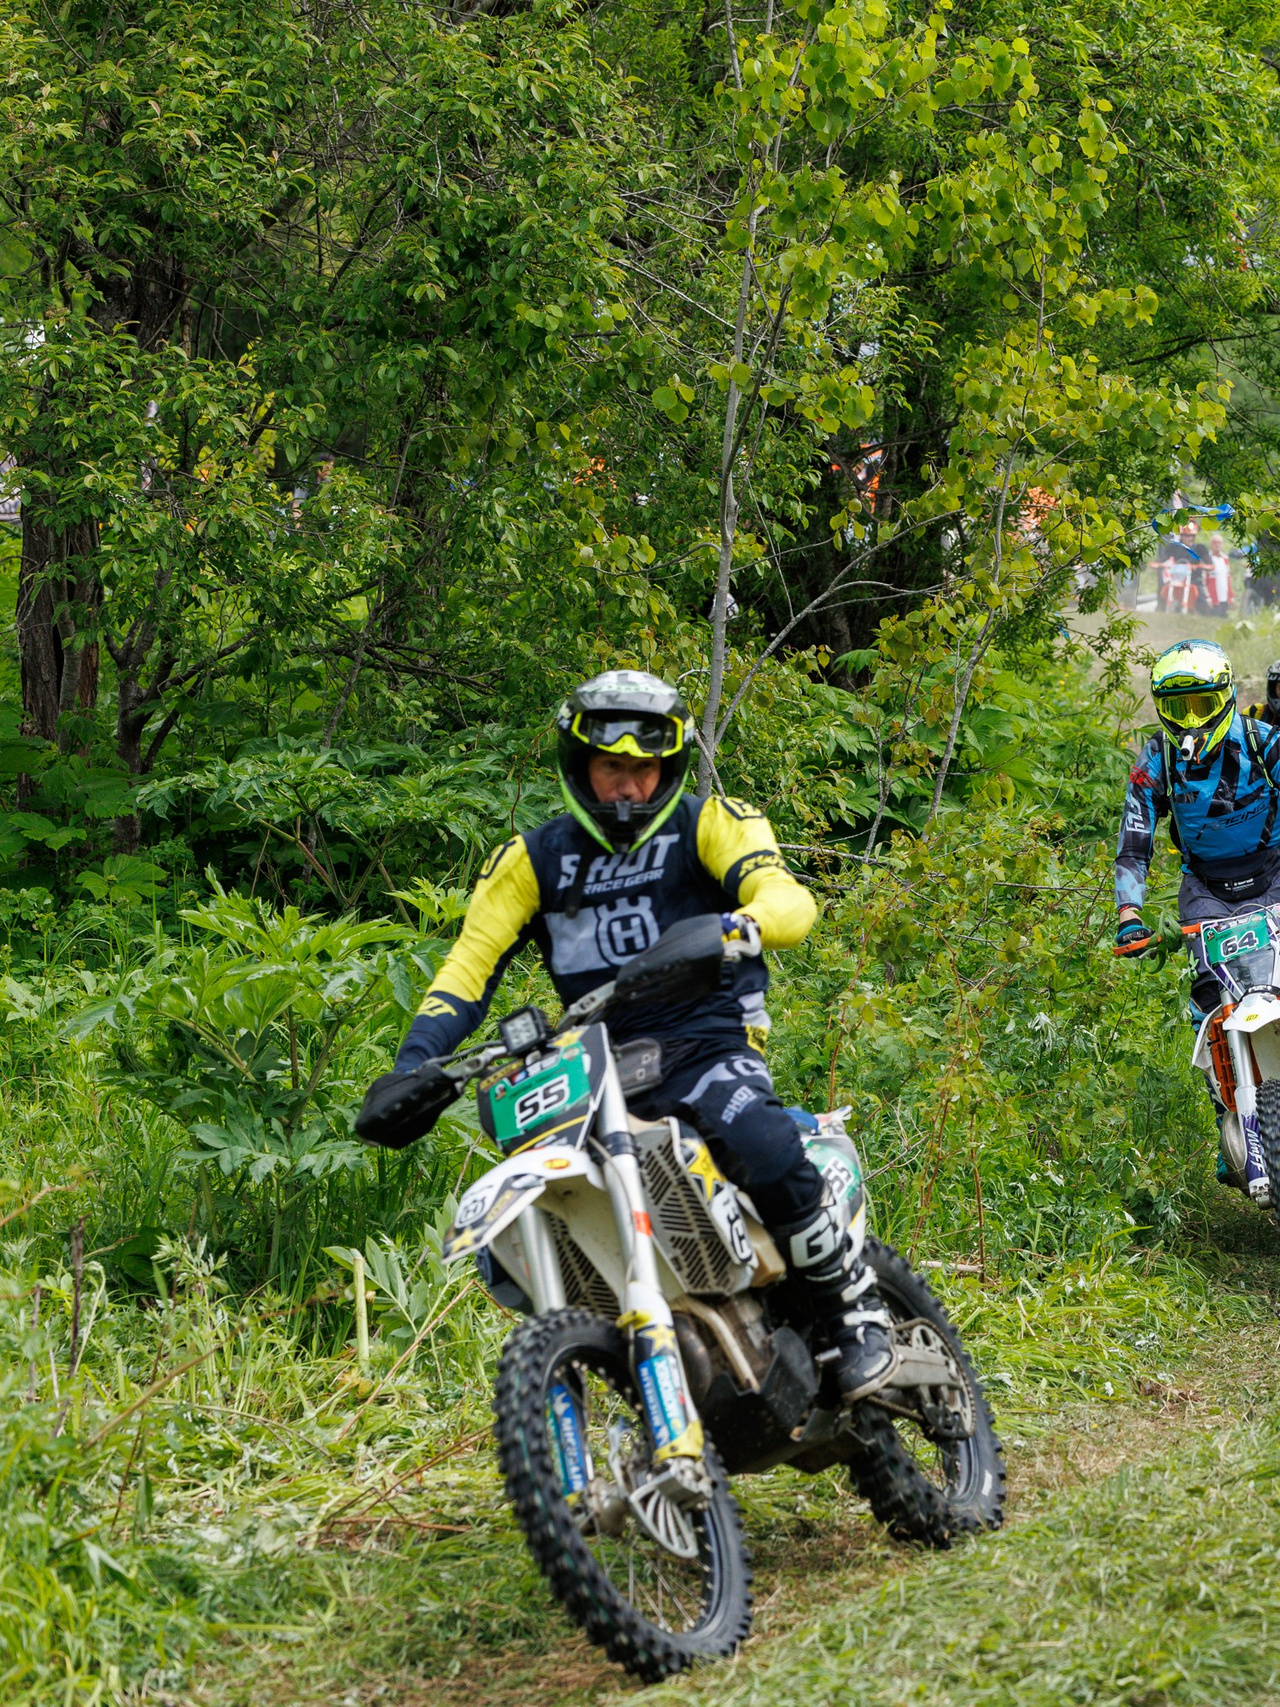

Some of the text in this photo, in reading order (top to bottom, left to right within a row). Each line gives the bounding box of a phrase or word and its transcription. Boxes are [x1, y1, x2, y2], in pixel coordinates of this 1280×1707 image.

[1126, 793, 1151, 834] FLY
[557, 833, 680, 890] SHOT
[583, 868, 665, 895] RACE GEAR
[1221, 930, 1259, 957] 64
[517, 1075, 571, 1129] 55
[821, 1156, 854, 1199] 55
